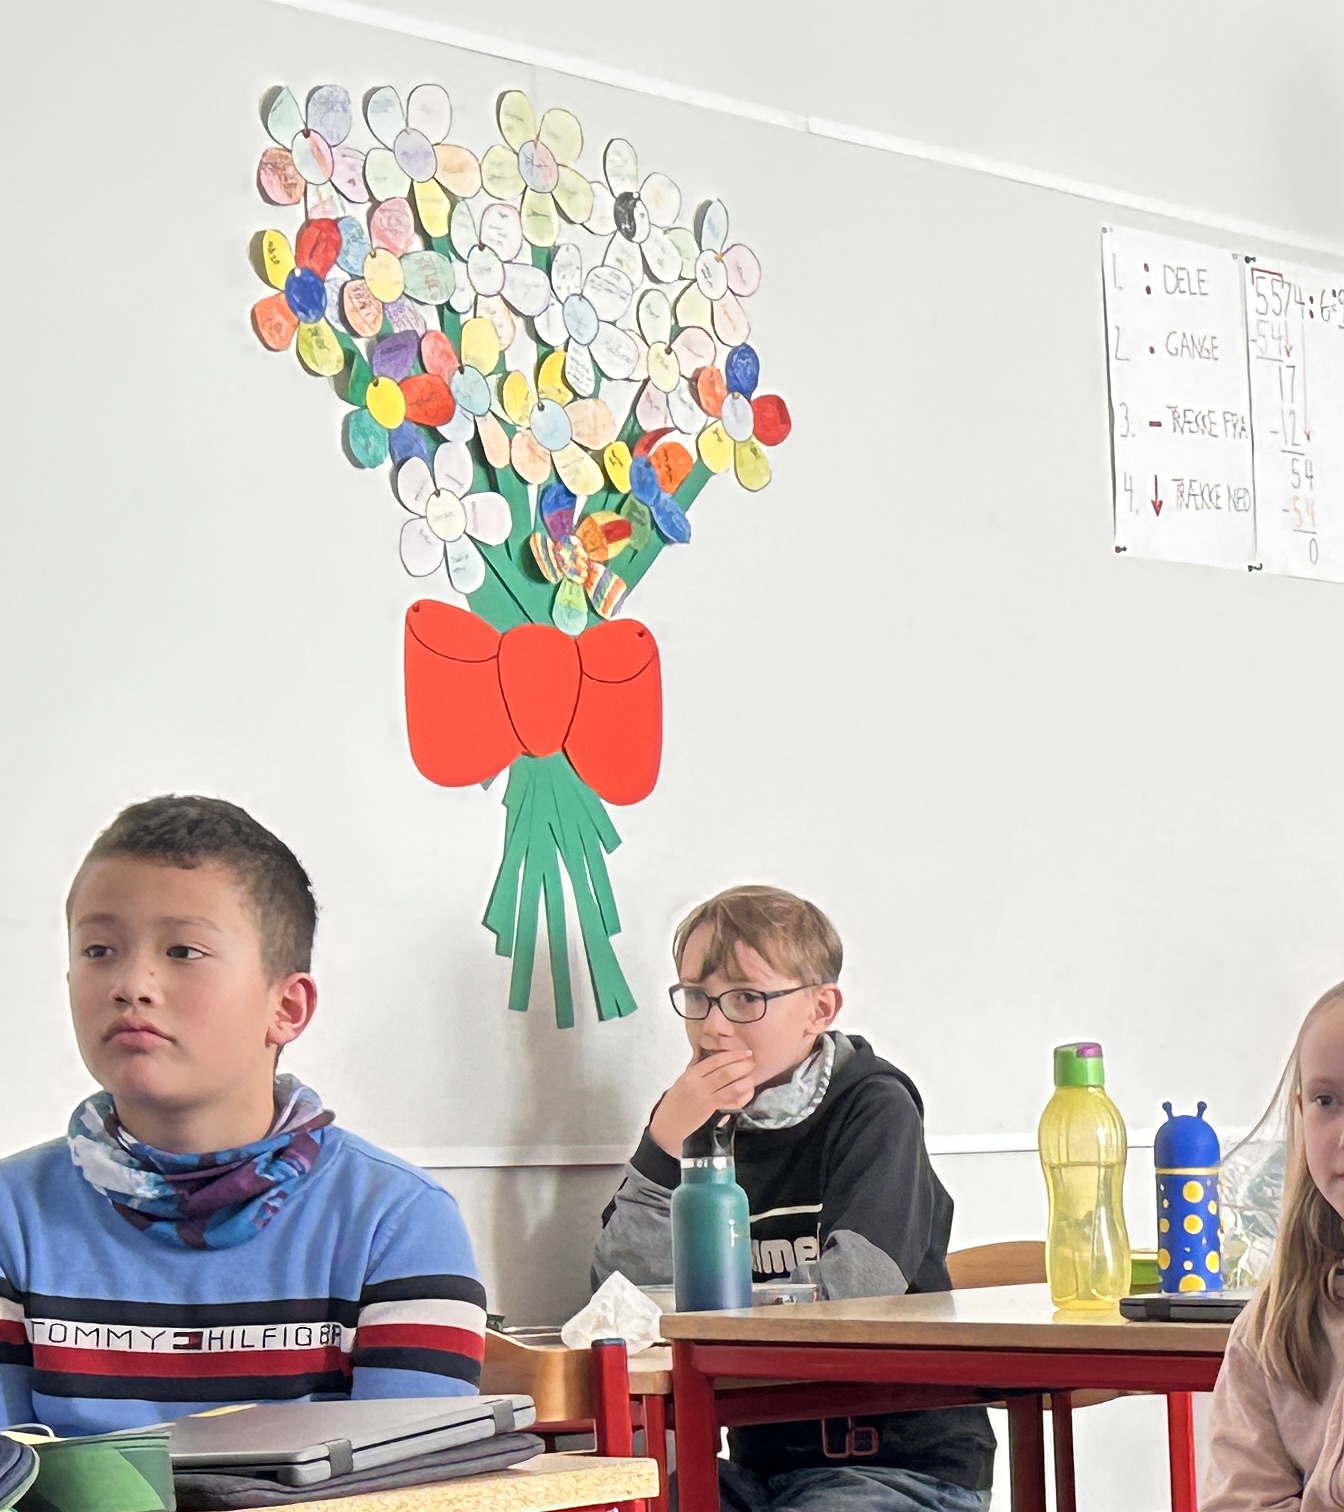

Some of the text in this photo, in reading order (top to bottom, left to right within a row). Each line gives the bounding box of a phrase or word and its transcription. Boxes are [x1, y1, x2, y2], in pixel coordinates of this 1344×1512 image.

[1163, 264, 1209, 296] DELE
[1165, 331, 1219, 361] GANGE
[1278, 364, 1296, 405] 17
[1119, 401, 1136, 438] 3.
[1222, 410, 1249, 440] FRA
[1291, 457, 1314, 492] 54
[1123, 471, 1140, 516] 4.
[30, 1321, 166, 1350] TOMMY
